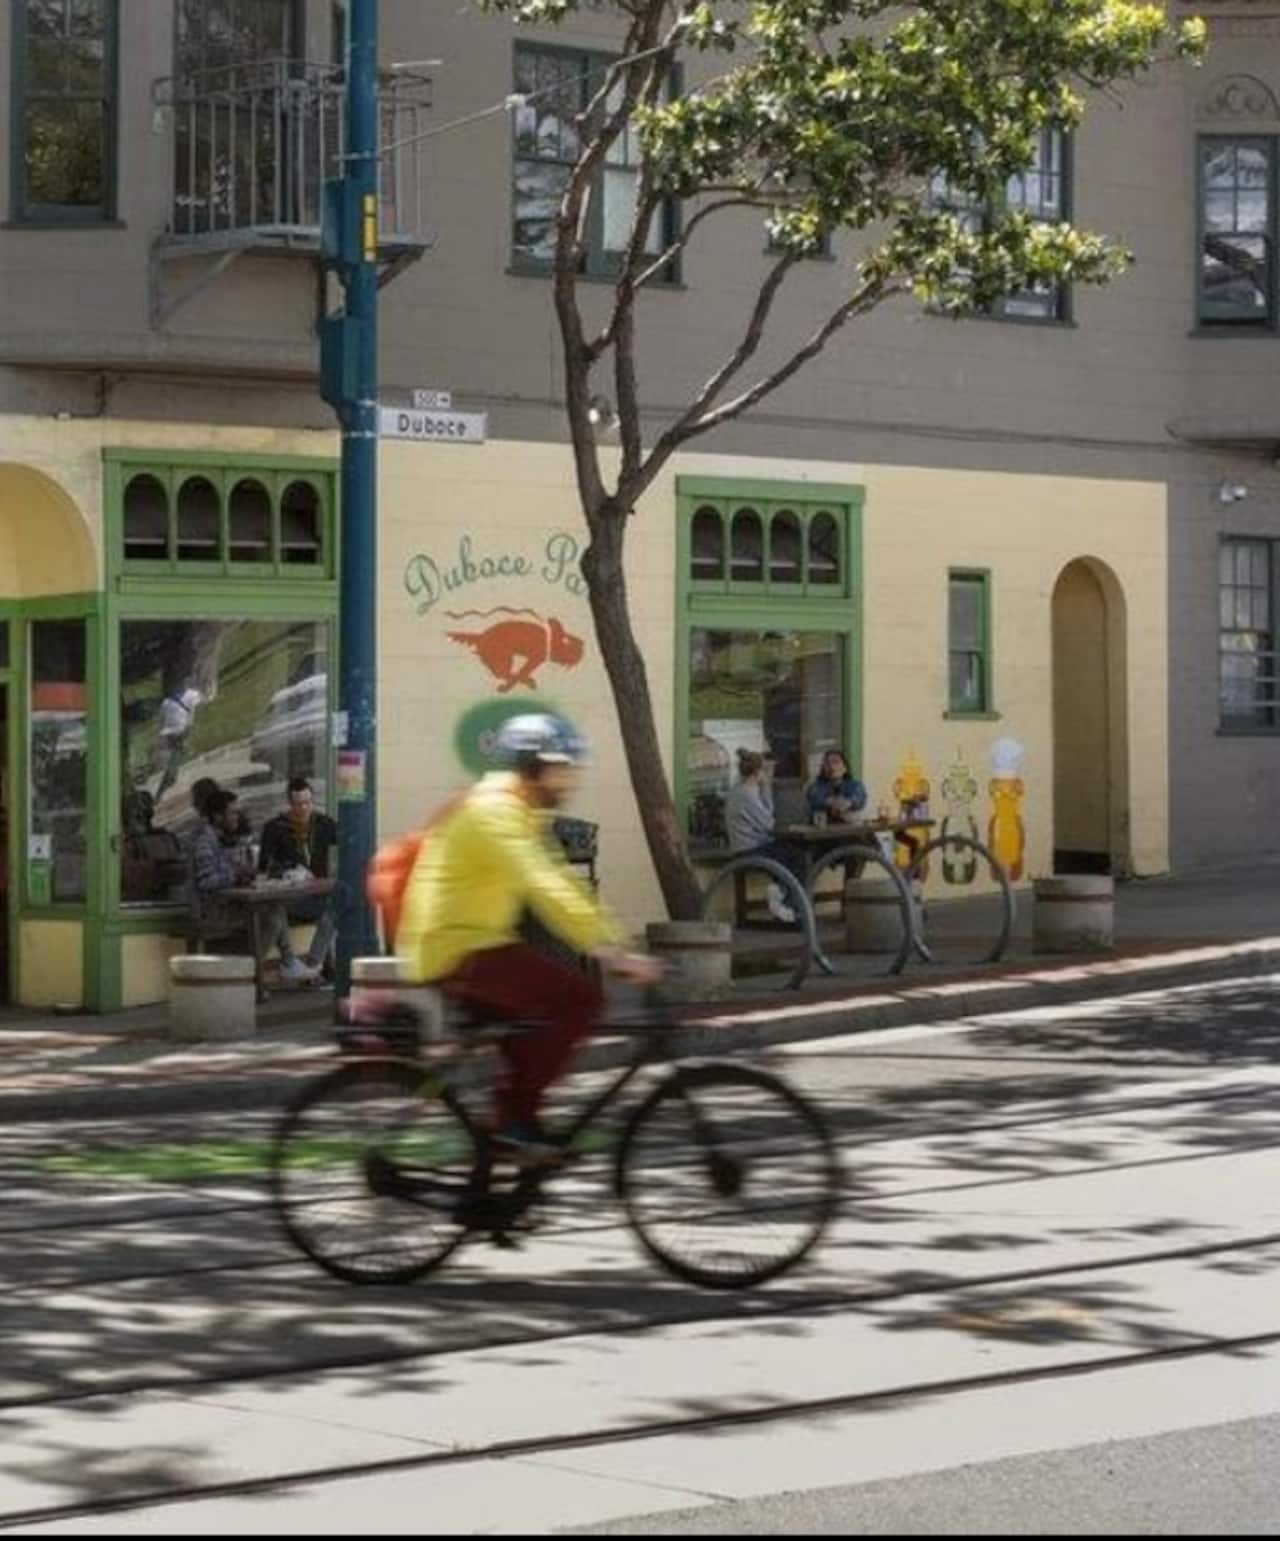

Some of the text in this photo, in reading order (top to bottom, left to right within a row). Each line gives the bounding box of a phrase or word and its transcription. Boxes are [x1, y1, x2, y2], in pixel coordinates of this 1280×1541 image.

[398, 413, 466, 437] Duboce
[403, 533, 589, 616] Duboce Pa
